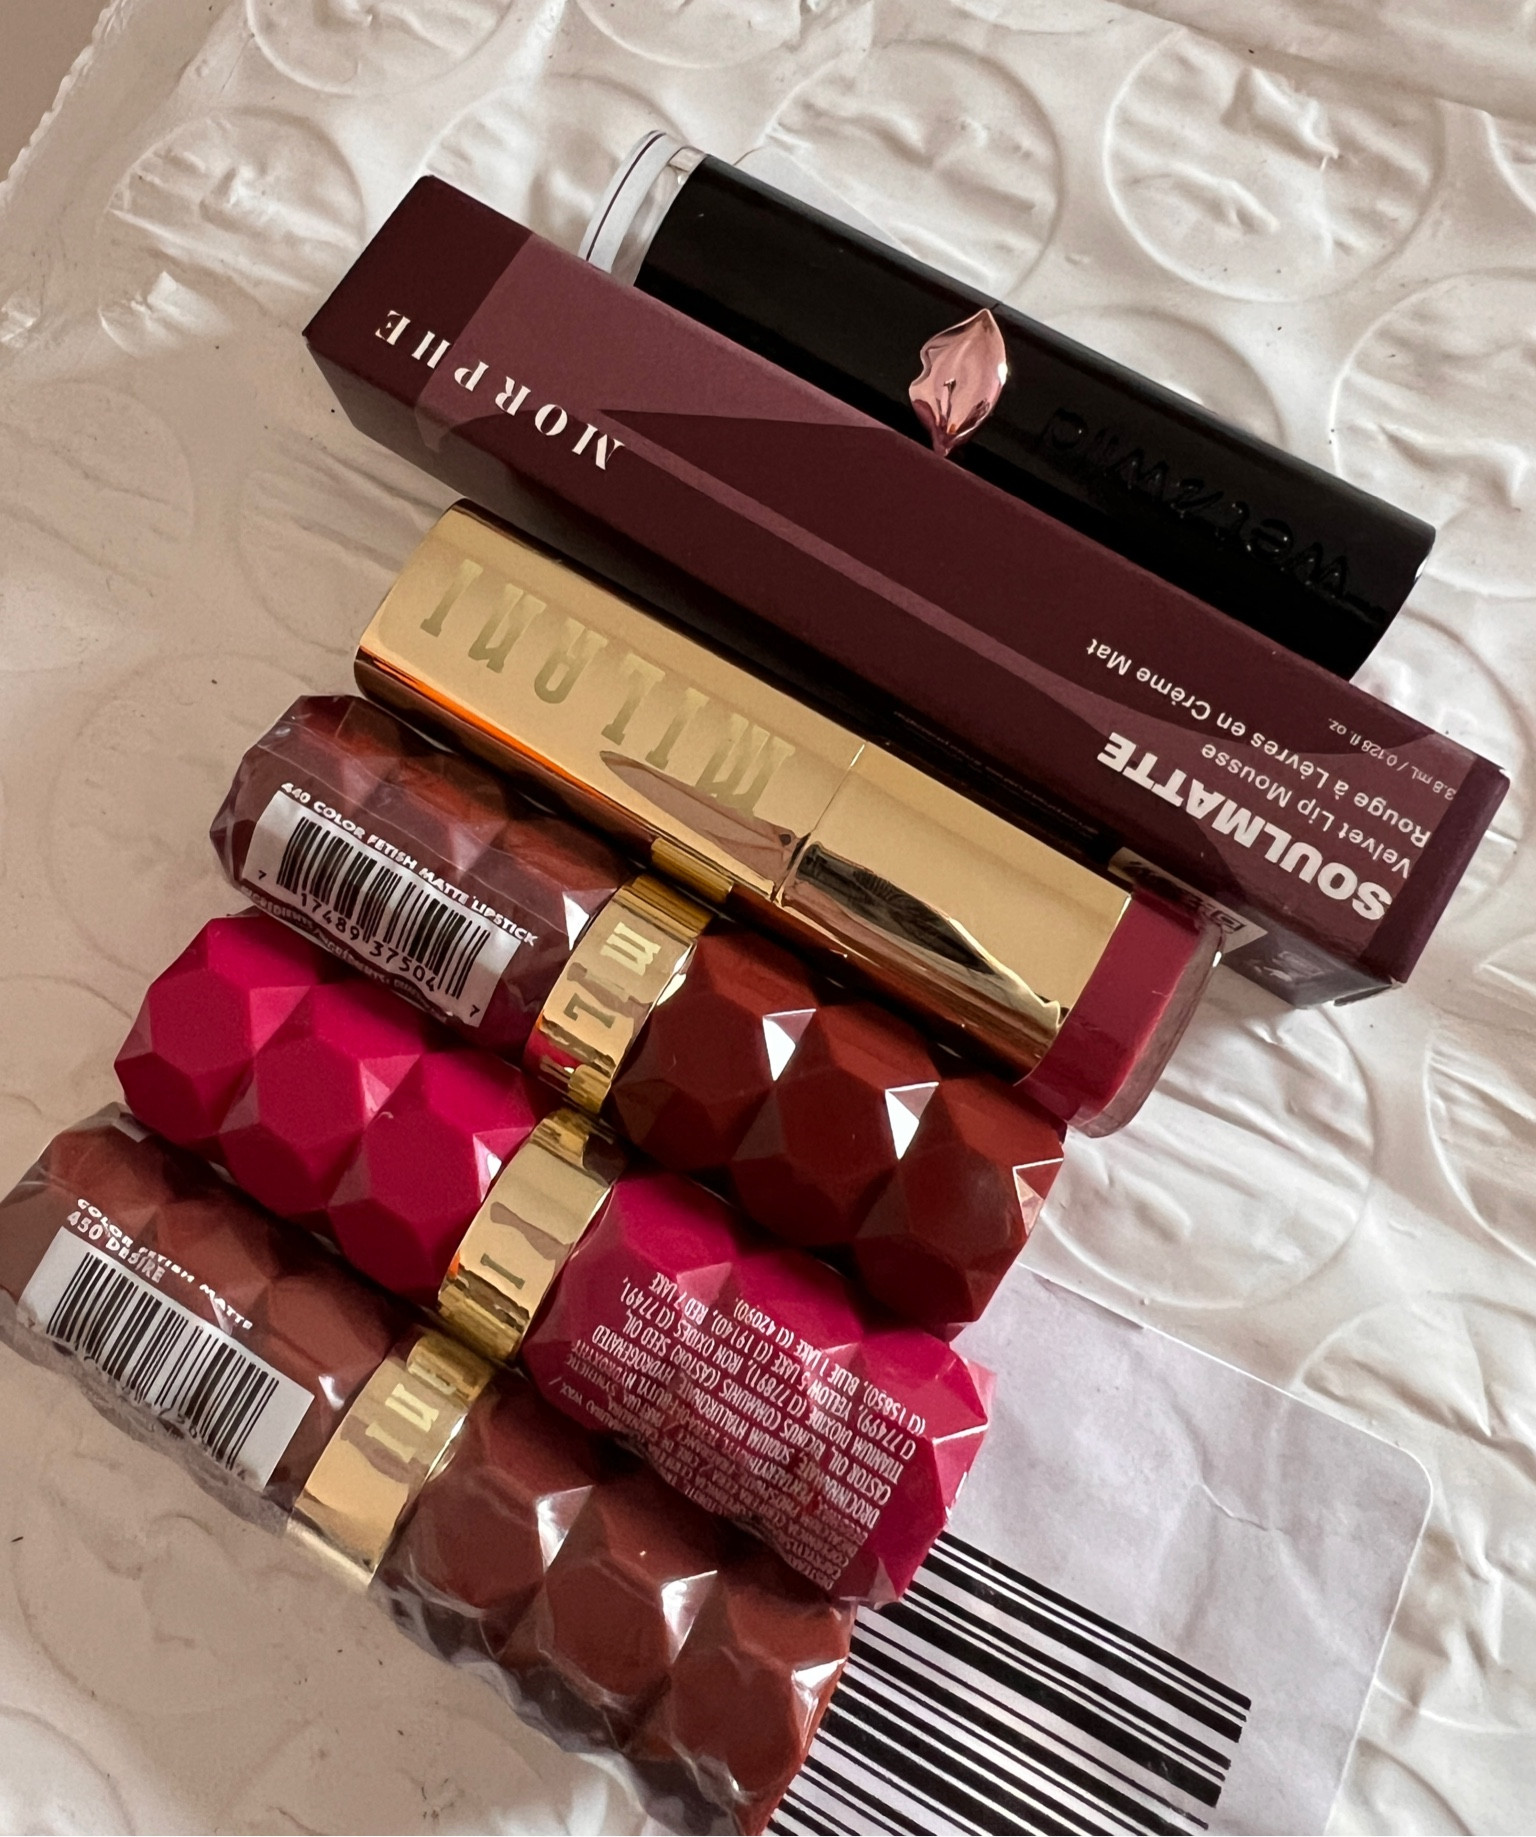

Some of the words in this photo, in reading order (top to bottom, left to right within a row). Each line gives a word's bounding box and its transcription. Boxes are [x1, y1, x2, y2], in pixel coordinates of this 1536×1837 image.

[372, 307, 626, 470] MORPHE
[1083, 636, 1133, 676] Mat
[418, 559, 796, 819] MILANI
[1133, 665, 1214, 723] Crème
[1214, 710, 1247, 739] en
[1324, 716, 1348, 737] oz.
[1344, 728, 1363, 746] fl.
[1246, 729, 1330, 789] Lèvres
[1360, 737, 1400, 767] 0.128
[1198, 740, 1293, 807] Mousse
[1329, 778, 1350, 800] à
[1430, 778, 1457, 801] 3.8
[1095, 730, 1394, 924] SOULMATTE
[1292, 792, 1336, 832] Lip
[1350, 785, 1432, 848] Rouge
[279, 778, 312, 805] 440
[311, 798, 367, 840] COLOR
[365, 833, 418, 870] FETISH
[417, 865, 470, 905] MATTE
[468, 897, 539, 947] LIPSTICK
[1336, 821, 1411, 879] Velvet
[254, 869, 266, 882] 7
[294, 891, 362, 942] 17489
[367, 939, 440, 993] 37504
[466, 1005, 479, 1019] 7
[65, 1209, 103, 1242] 450
[104, 1236, 166, 1284] DESIRE
[74, 1196, 134, 1249] COLOR
[137, 1244, 196, 1284] FETISH
[198, 1282, 254, 1331] MATTE
[618, 1276, 659, 1319] 77491,
[647, 1270, 678, 1303] LAKE
[673, 1290, 687, 1307] 7
[621, 1308, 644, 1338] OIL,
[654, 1305, 677, 1330] (CI
[682, 1295, 709, 1325] RED
[731, 1296, 777, 1337] 42090).
[638, 1324, 672, 1356] SEED
[671, 1317, 717, 1356] OXIDES
[710, 1308, 754, 1353] 19140),
[775, 1326, 795, 1349] (CI
[589, 1322, 676, 1385] HYDROGENATED
[669, 1343, 720, 1391] (CASTOR)
[711, 1343, 743, 1375] IRON
[752, 1339, 775, 1364] (CI
[770, 1351, 801, 1383] LAKE
[792, 1337, 823, 1367] LAKE
[819, 1357, 830, 1375] 1
[743, 1358, 791, 1407] 77891),
[795, 1369, 811, 1390] 5
[827, 1362, 861, 1394] BLUE
[717, 1376, 783, 1432] COMMUNIS
[786, 1392, 808, 1417] (CI
[806, 1377, 849, 1420] YELLOW
[860, 1379, 908, 1424] 15850),
[745, 1425, 795, 1464] SODIUM
[777, 1416, 827, 1460] RICINUS
[804, 1404, 854, 1448] DIOXIDE
[854, 1402, 904, 1452] 77499),
[905, 1412, 928, 1438] (CI
[825, 1445, 850, 1477] OIL,
[848, 1434, 905, 1484] TITANIUM
[899, 1438, 917, 1461] CI
[844, 1462, 893, 1506] CASTOR
